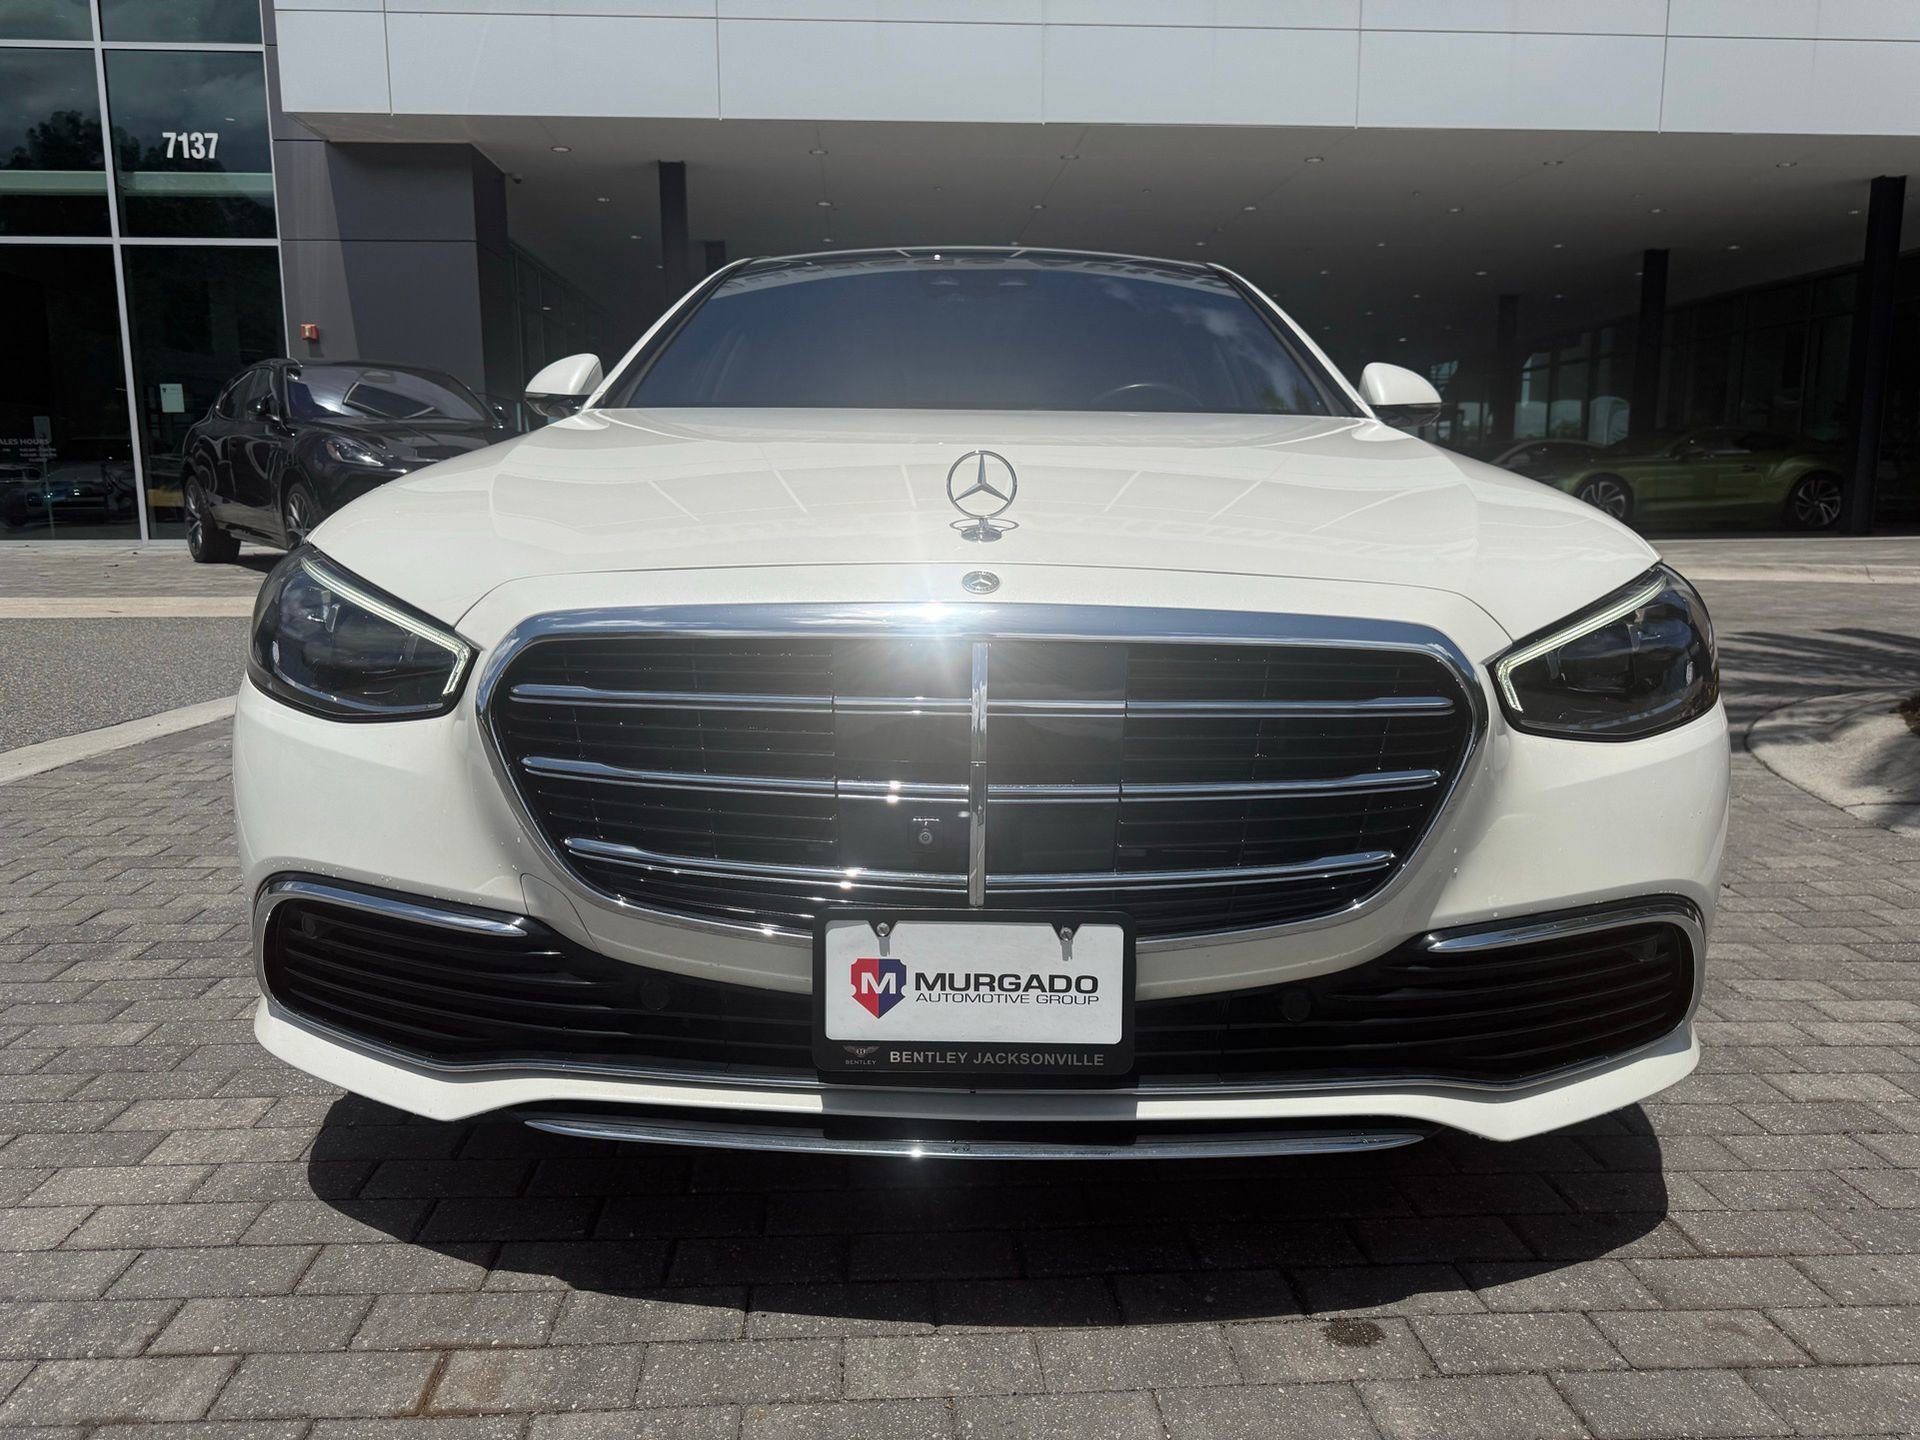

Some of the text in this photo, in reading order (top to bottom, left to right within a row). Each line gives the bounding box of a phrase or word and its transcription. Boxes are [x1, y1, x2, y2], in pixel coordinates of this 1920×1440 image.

[162, 132, 218, 159] 7137
[861, 972, 897, 994] M
[914, 972, 1099, 994] MURGADO
[915, 992, 1099, 1005] AUTOMOTIVE GROUP
[890, 1051, 1105, 1066] BENTLEY JACKSONVILLE
